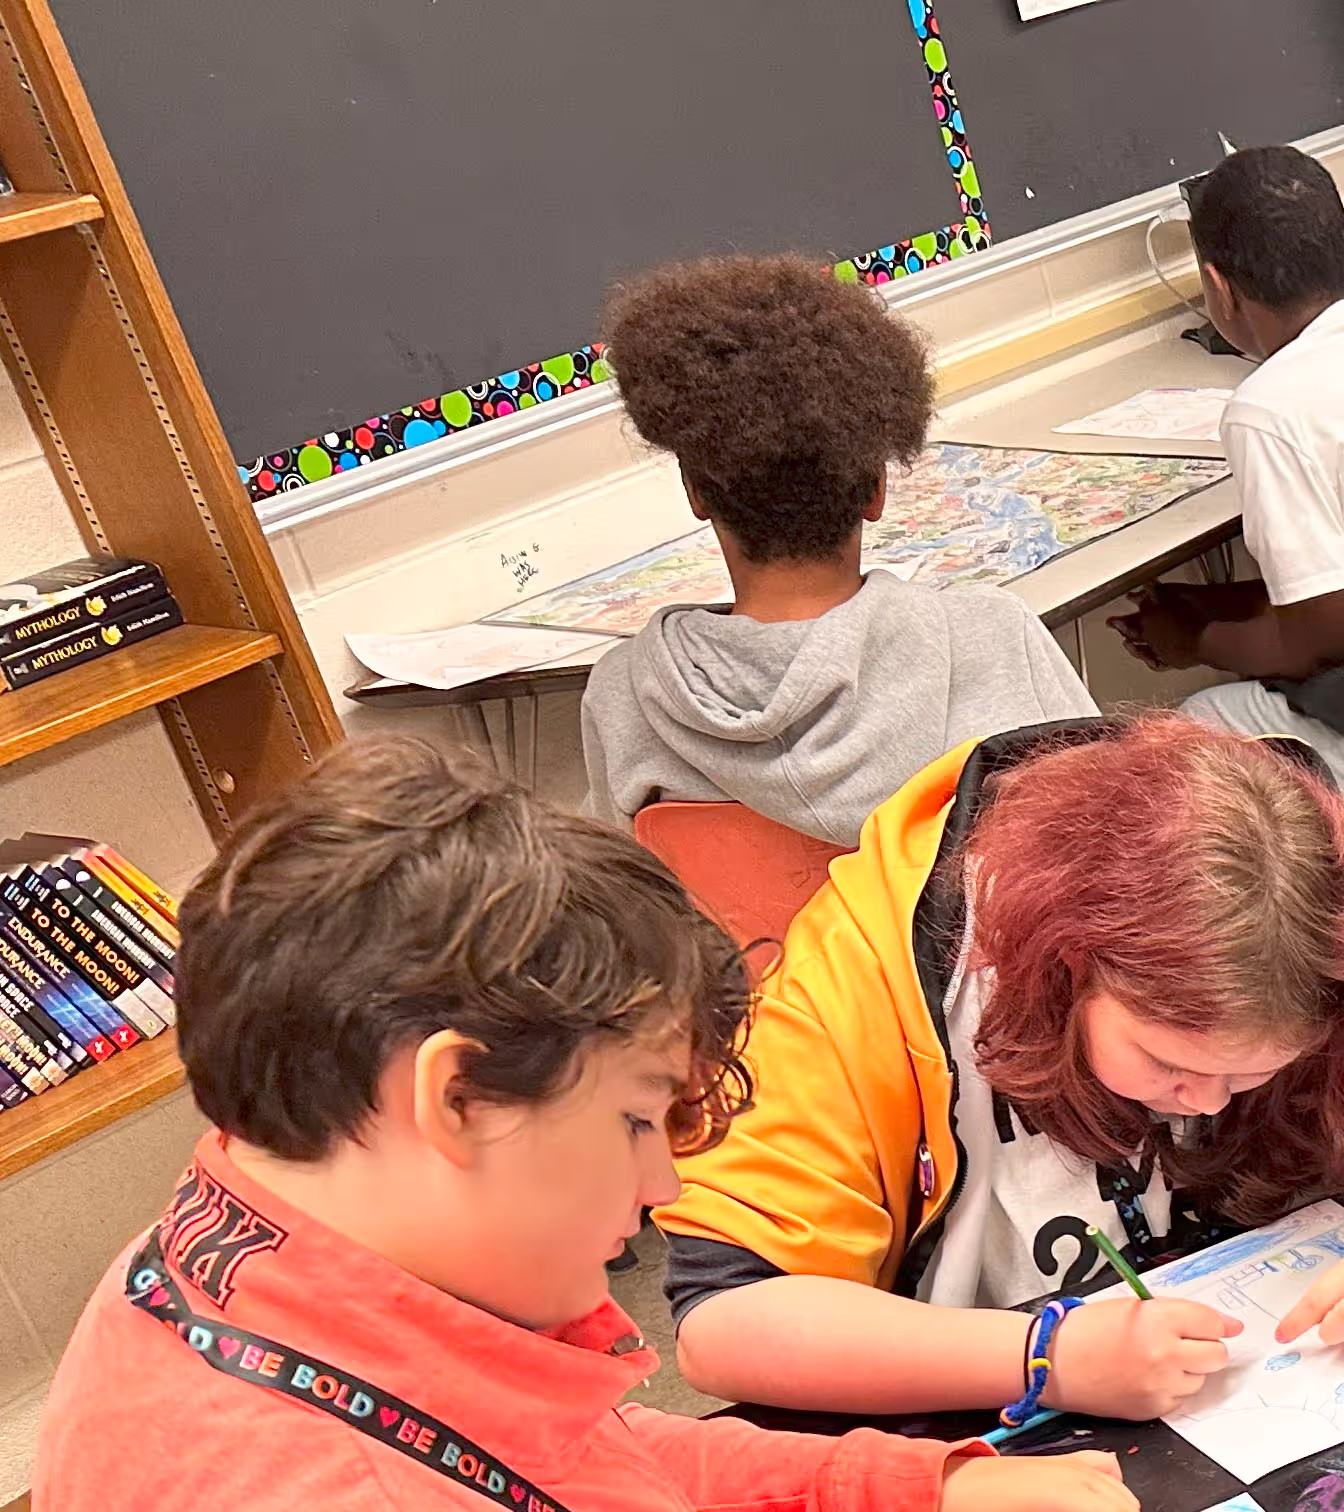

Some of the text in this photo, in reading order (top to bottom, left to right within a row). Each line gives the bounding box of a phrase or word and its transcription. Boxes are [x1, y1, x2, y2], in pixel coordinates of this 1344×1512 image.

[15, 606, 81, 640] MYTHOLOGY
[32, 636, 98, 670] MYTHOLOGY
[0, 938, 46, 990] DURANCE
[7, 916, 71, 979] ENDURANCE
[31, 907, 120, 995] TO THE MOON!
[52, 898, 141, 984] TO THE MOON!
[0, 990, 21, 1018] PACE
[5, 982, 35, 1012] SPACE
[239, 1343, 285, 1378] BE
[291, 1363, 375, 1418] BOLD
[396, 1417, 437, 1454] BE
[441, 1442, 506, 1494] BOLD
